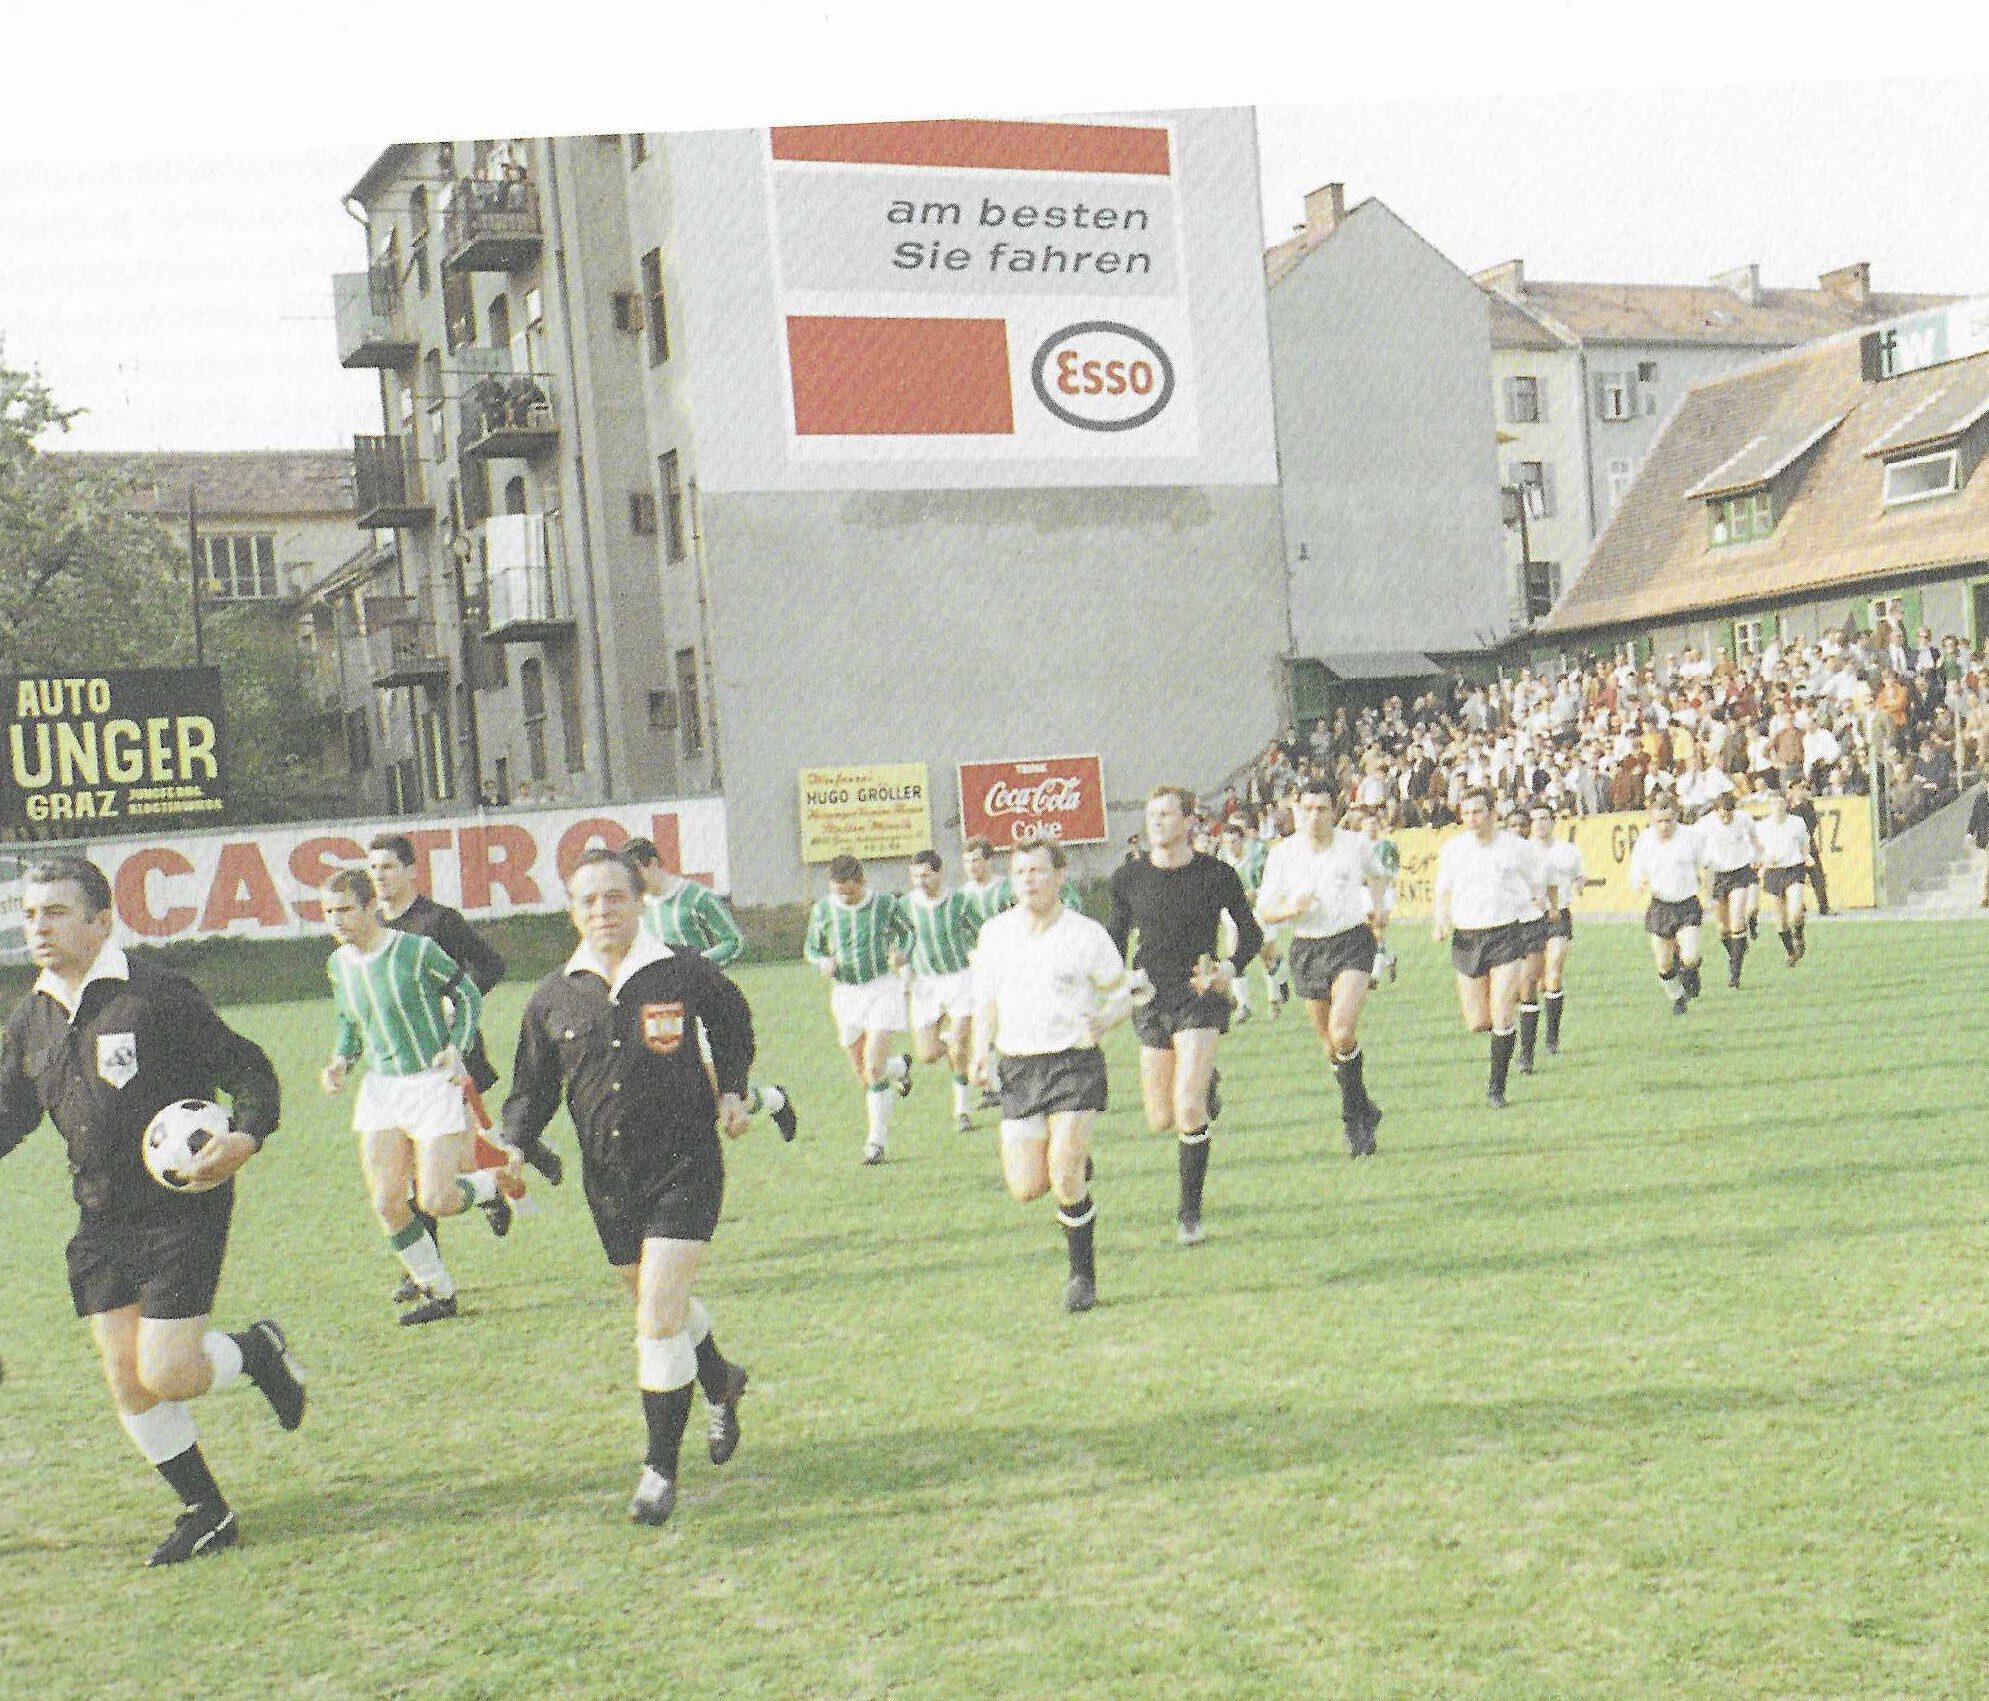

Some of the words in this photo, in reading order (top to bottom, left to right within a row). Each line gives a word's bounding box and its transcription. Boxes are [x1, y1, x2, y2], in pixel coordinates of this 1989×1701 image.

[886, 199, 962, 225] am
[978, 197, 1150, 231] besten
[891, 240, 971, 271] Sie
[988, 241, 1151, 275] fahren
[17, 678, 111, 717] AUTO
[9, 716, 218, 788] UNGER
[26, 790, 120, 822] GRAZ
[806, 788, 849, 805] HUGO
[983, 776, 1082, 817] Coca-Cola
[1011, 819, 1062, 842] Coke
